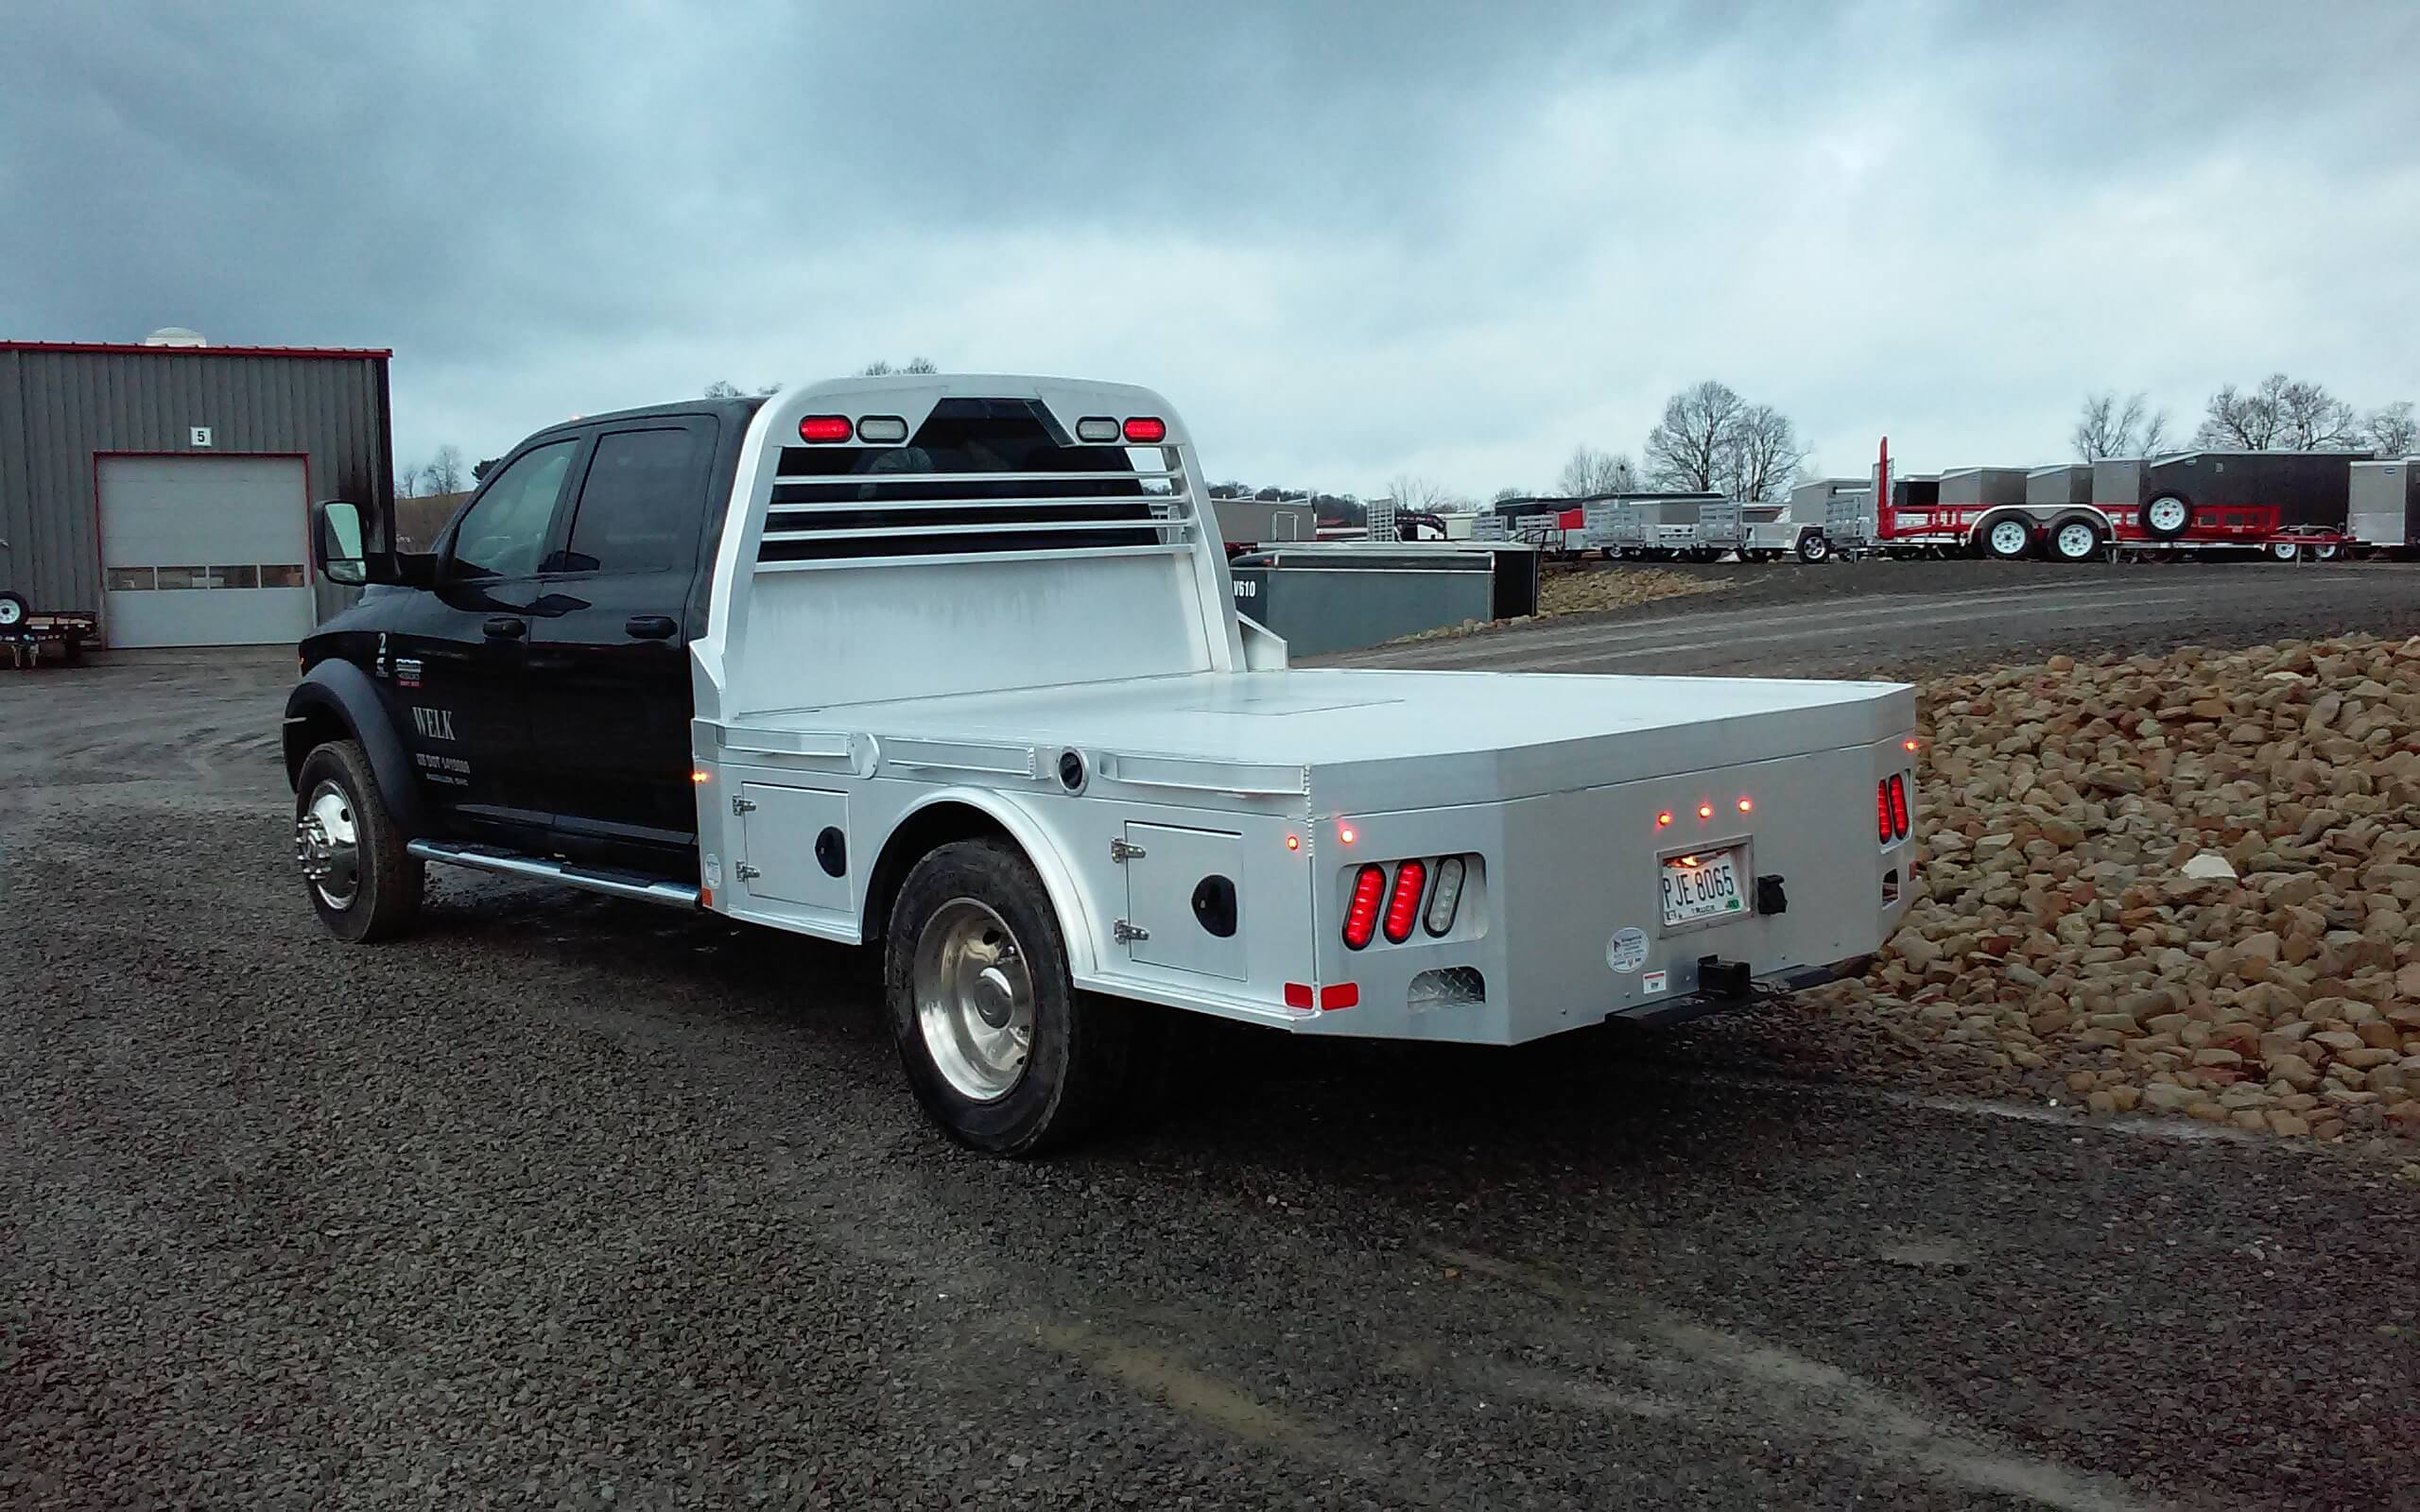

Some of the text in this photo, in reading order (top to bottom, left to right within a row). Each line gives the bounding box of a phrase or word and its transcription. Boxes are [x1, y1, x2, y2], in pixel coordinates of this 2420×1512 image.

[198, 430, 205, 442] 5
[1233, 580, 1256, 597] V610
[412, 706, 456, 741] WELK
[1663, 865, 1735, 908] PJE 8065
